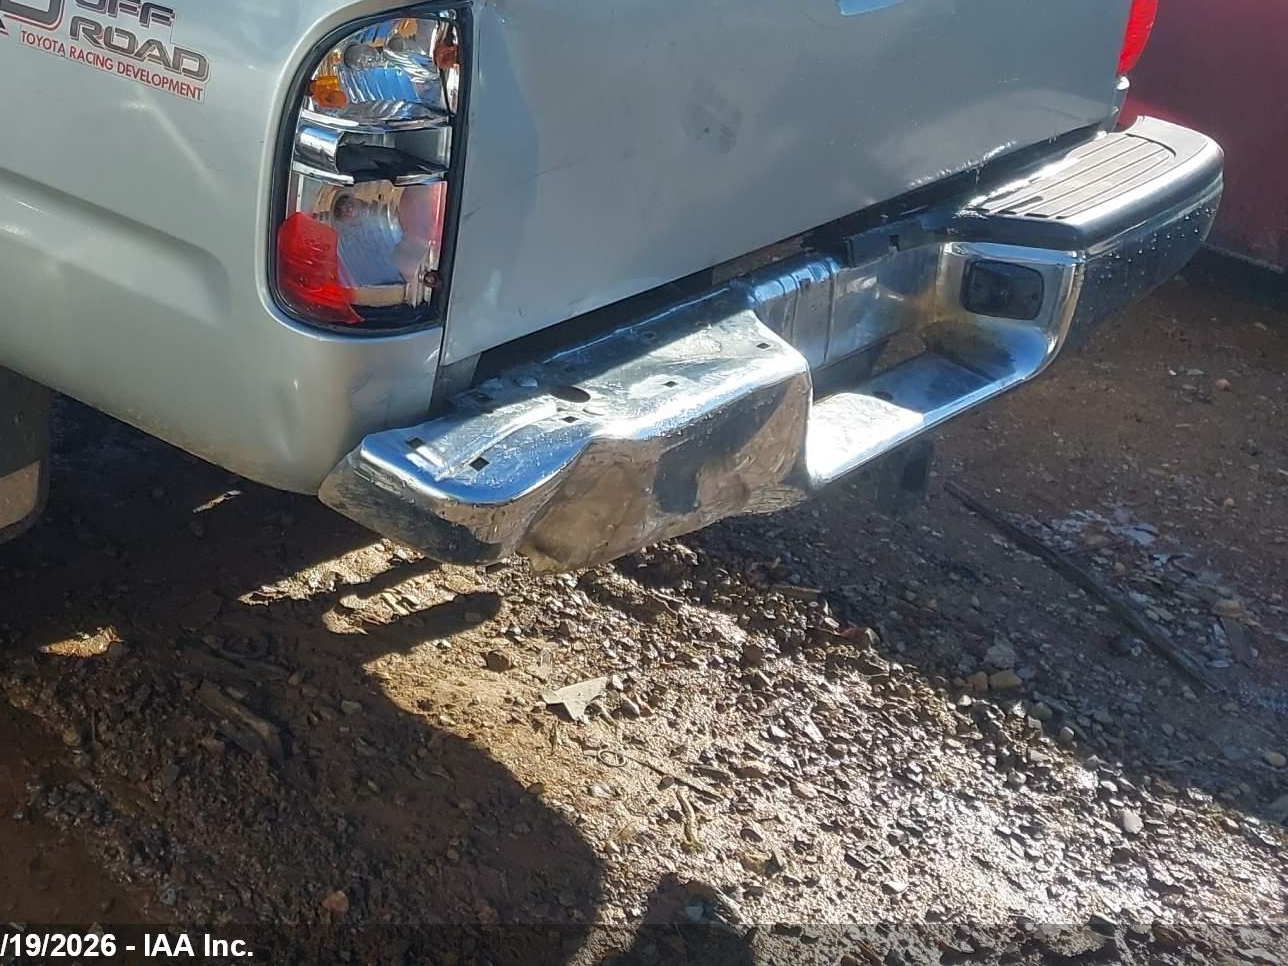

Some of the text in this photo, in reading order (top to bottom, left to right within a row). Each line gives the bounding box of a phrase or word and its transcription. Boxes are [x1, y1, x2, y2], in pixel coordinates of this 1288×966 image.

[20, 29, 203, 102] TOYOTA RACING DEVELOPMENT
[69, 14, 210, 83] ROAD
